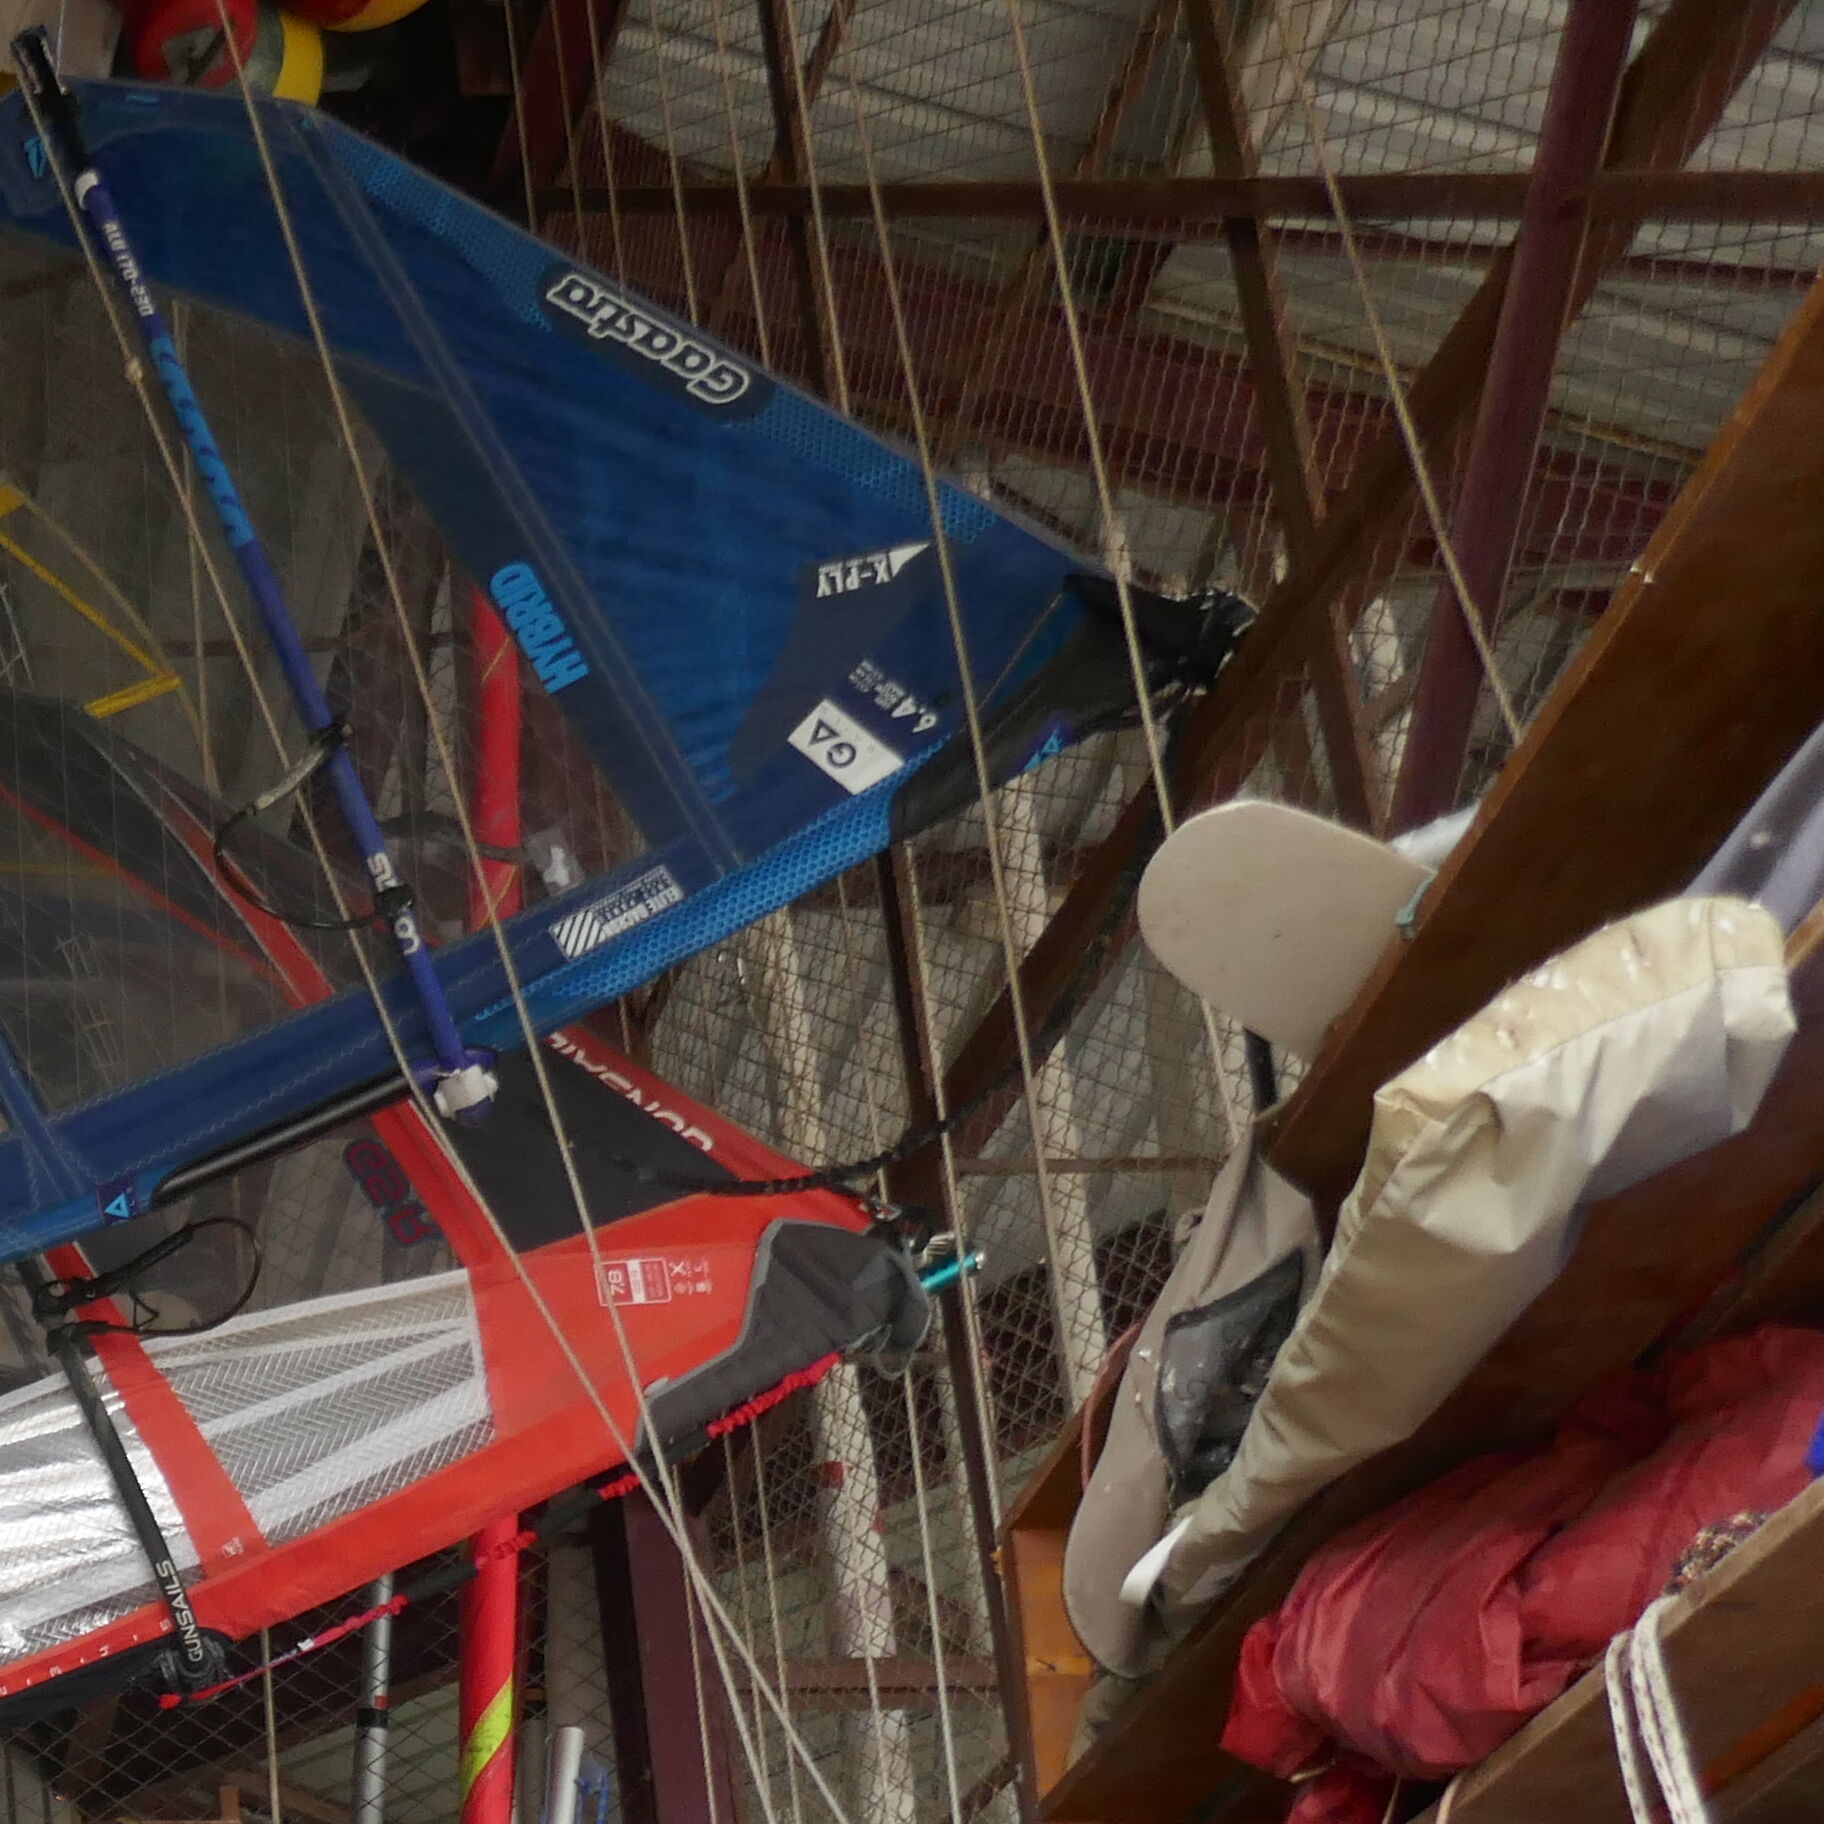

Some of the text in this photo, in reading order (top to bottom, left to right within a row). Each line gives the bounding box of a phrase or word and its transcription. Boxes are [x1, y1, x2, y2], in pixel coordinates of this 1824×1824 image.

[545, 272, 751, 406] Gaastra
[489, 560, 590, 696] HYBRID
[816, 551, 895, 600] X-PLY
[153, 1558, 206, 1663] GUNSAILS
